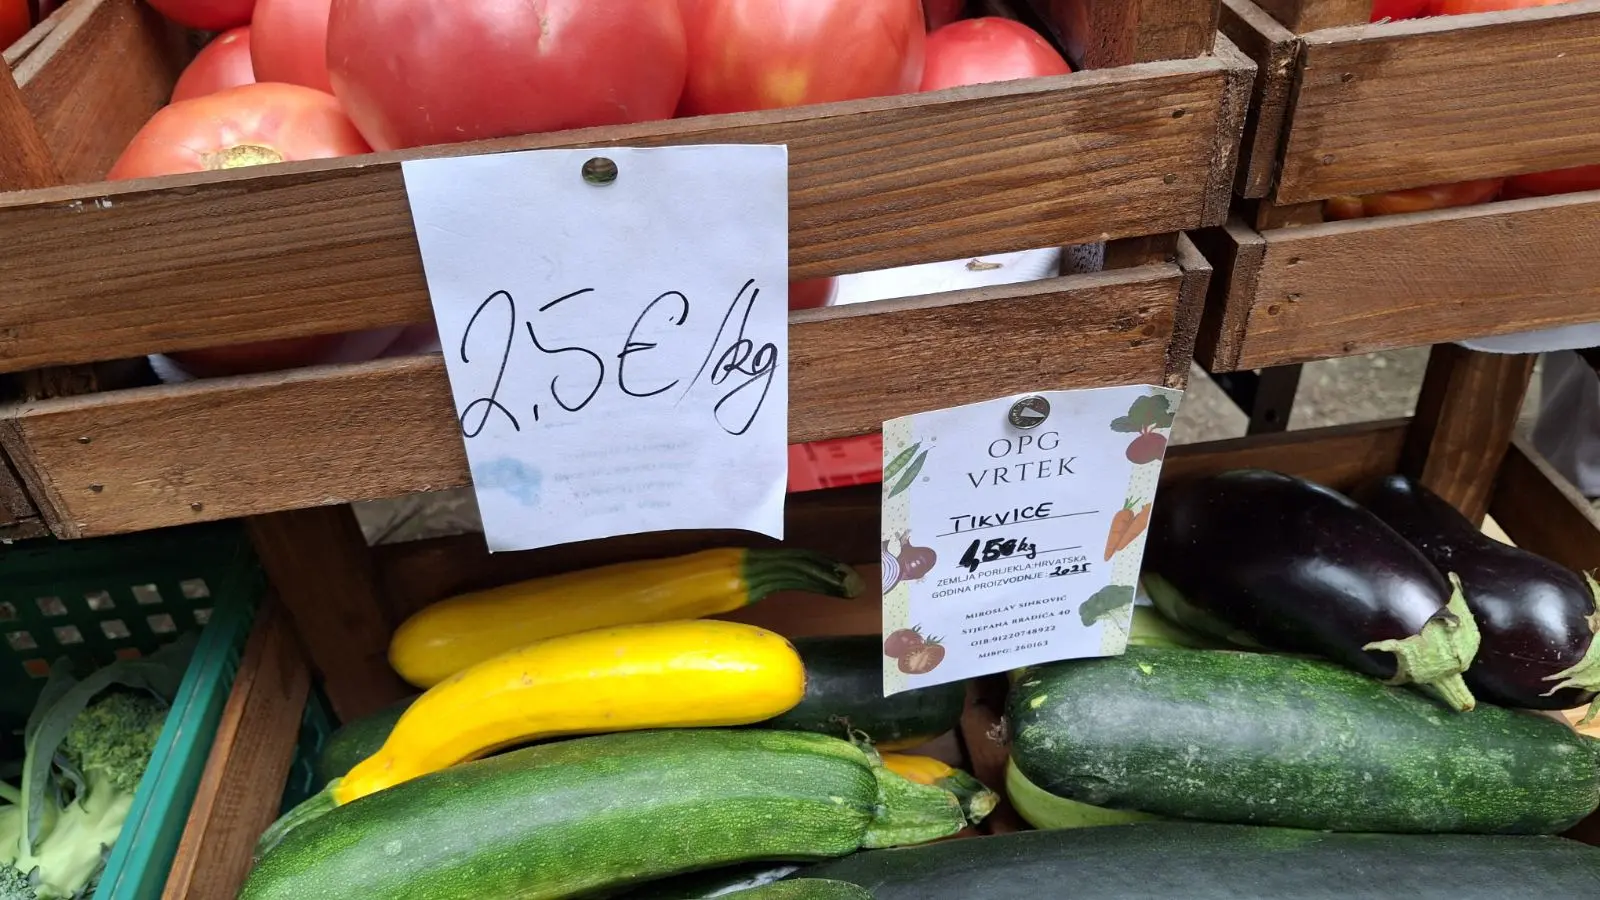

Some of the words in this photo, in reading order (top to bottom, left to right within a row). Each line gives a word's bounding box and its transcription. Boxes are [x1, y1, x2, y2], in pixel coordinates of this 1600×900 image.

[987, 431, 1060, 459] OPG
[967, 456, 1078, 489] VRTEK
[949, 502, 1054, 534] TIKVICE
[931, 586, 971, 599] GODINA
[1049, 562, 1092, 577] 2025
[936, 574, 976, 587] ZEMLJA
[961, 621, 1009, 635] STJEPANA
[1058, 609, 1071, 617] 40
[965, 604, 1017, 620] MIROSLAV
